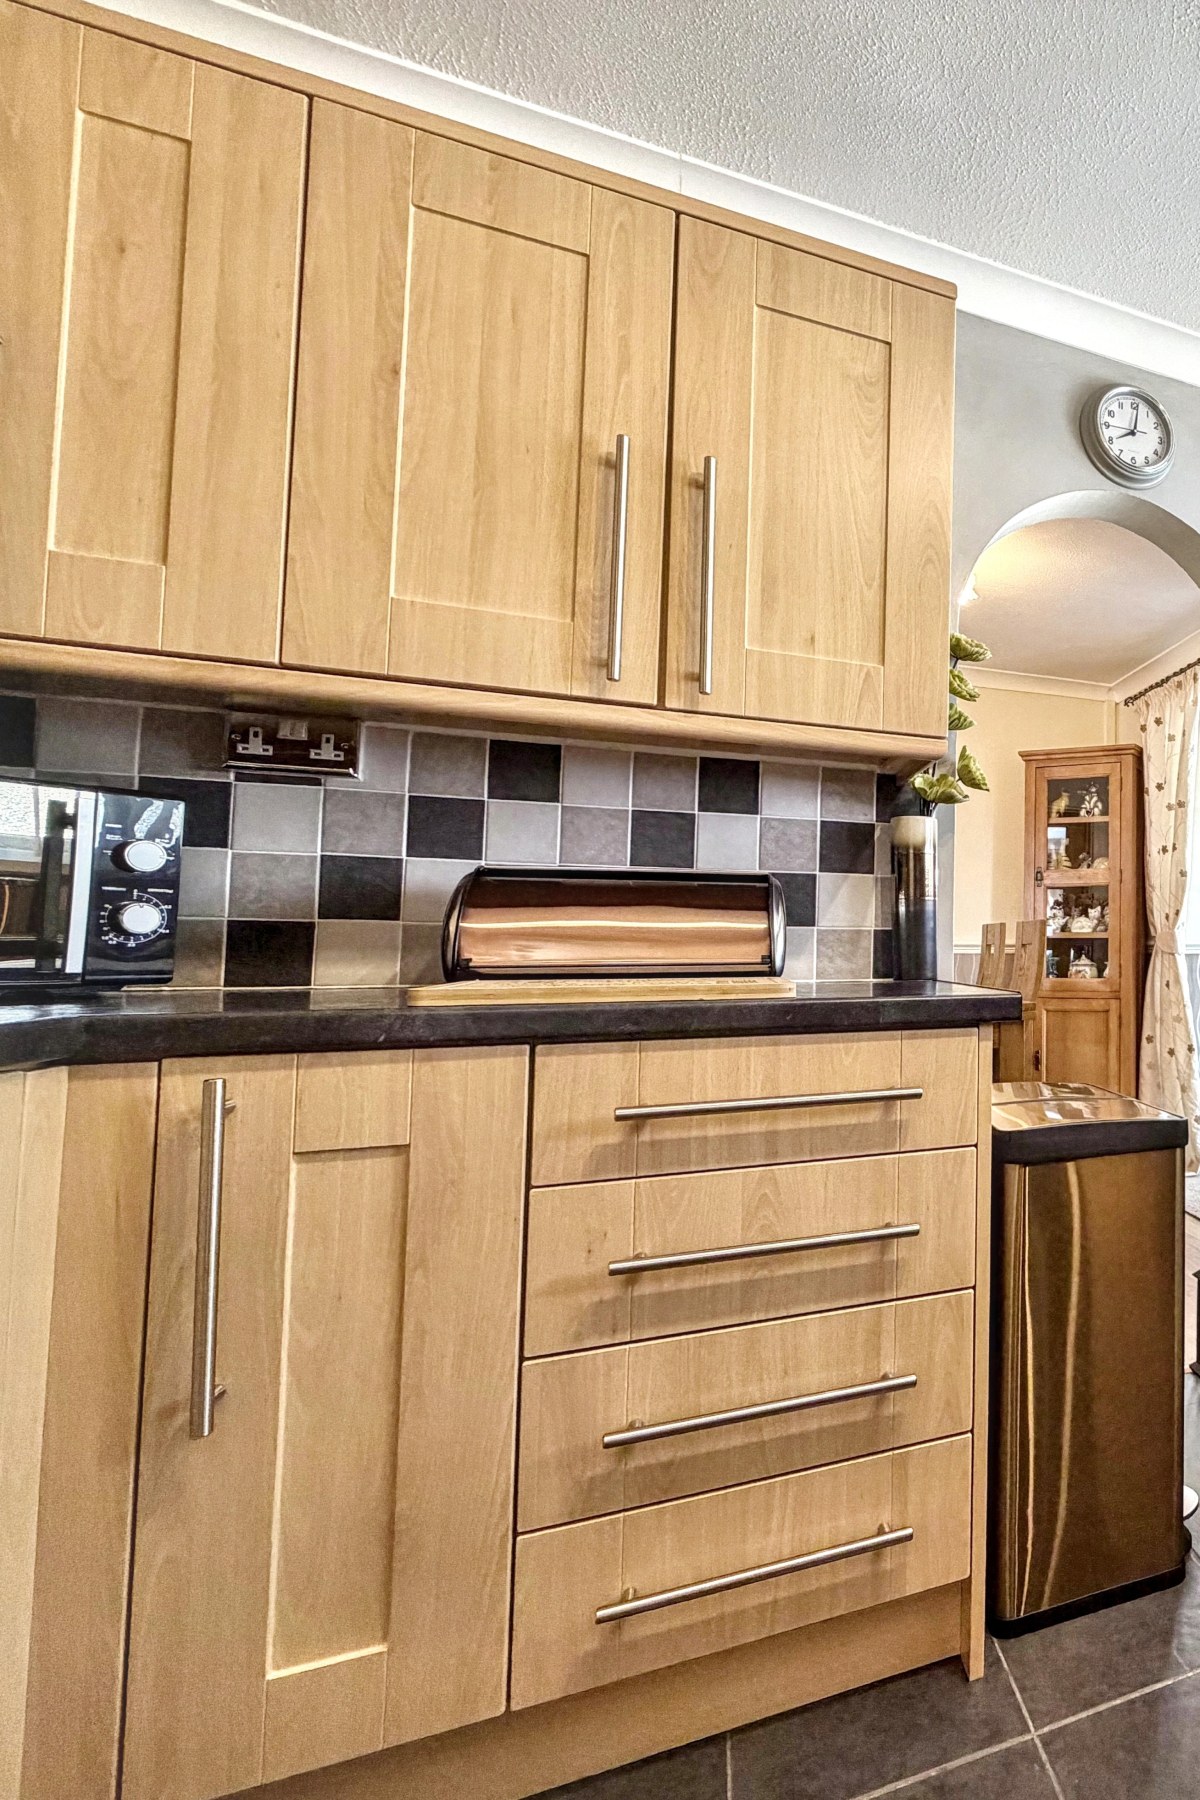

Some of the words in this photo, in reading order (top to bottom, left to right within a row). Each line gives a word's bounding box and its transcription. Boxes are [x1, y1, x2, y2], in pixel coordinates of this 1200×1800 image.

[1118, 401, 1123, 410] 11
[1131, 401, 1138, 410] 12
[1107, 409, 1115, 418] 10
[1103, 421, 1110, 429] 9
[1153, 421, 1159, 430] 2
[1108, 436, 1113, 445] 8
[1157, 436, 1163, 445] 3
[1118, 448, 1123, 457] 7
[1153, 448, 1159, 457] 4
[1130, 456, 1137, 464] 6
[1144, 456, 1149, 464] 5
